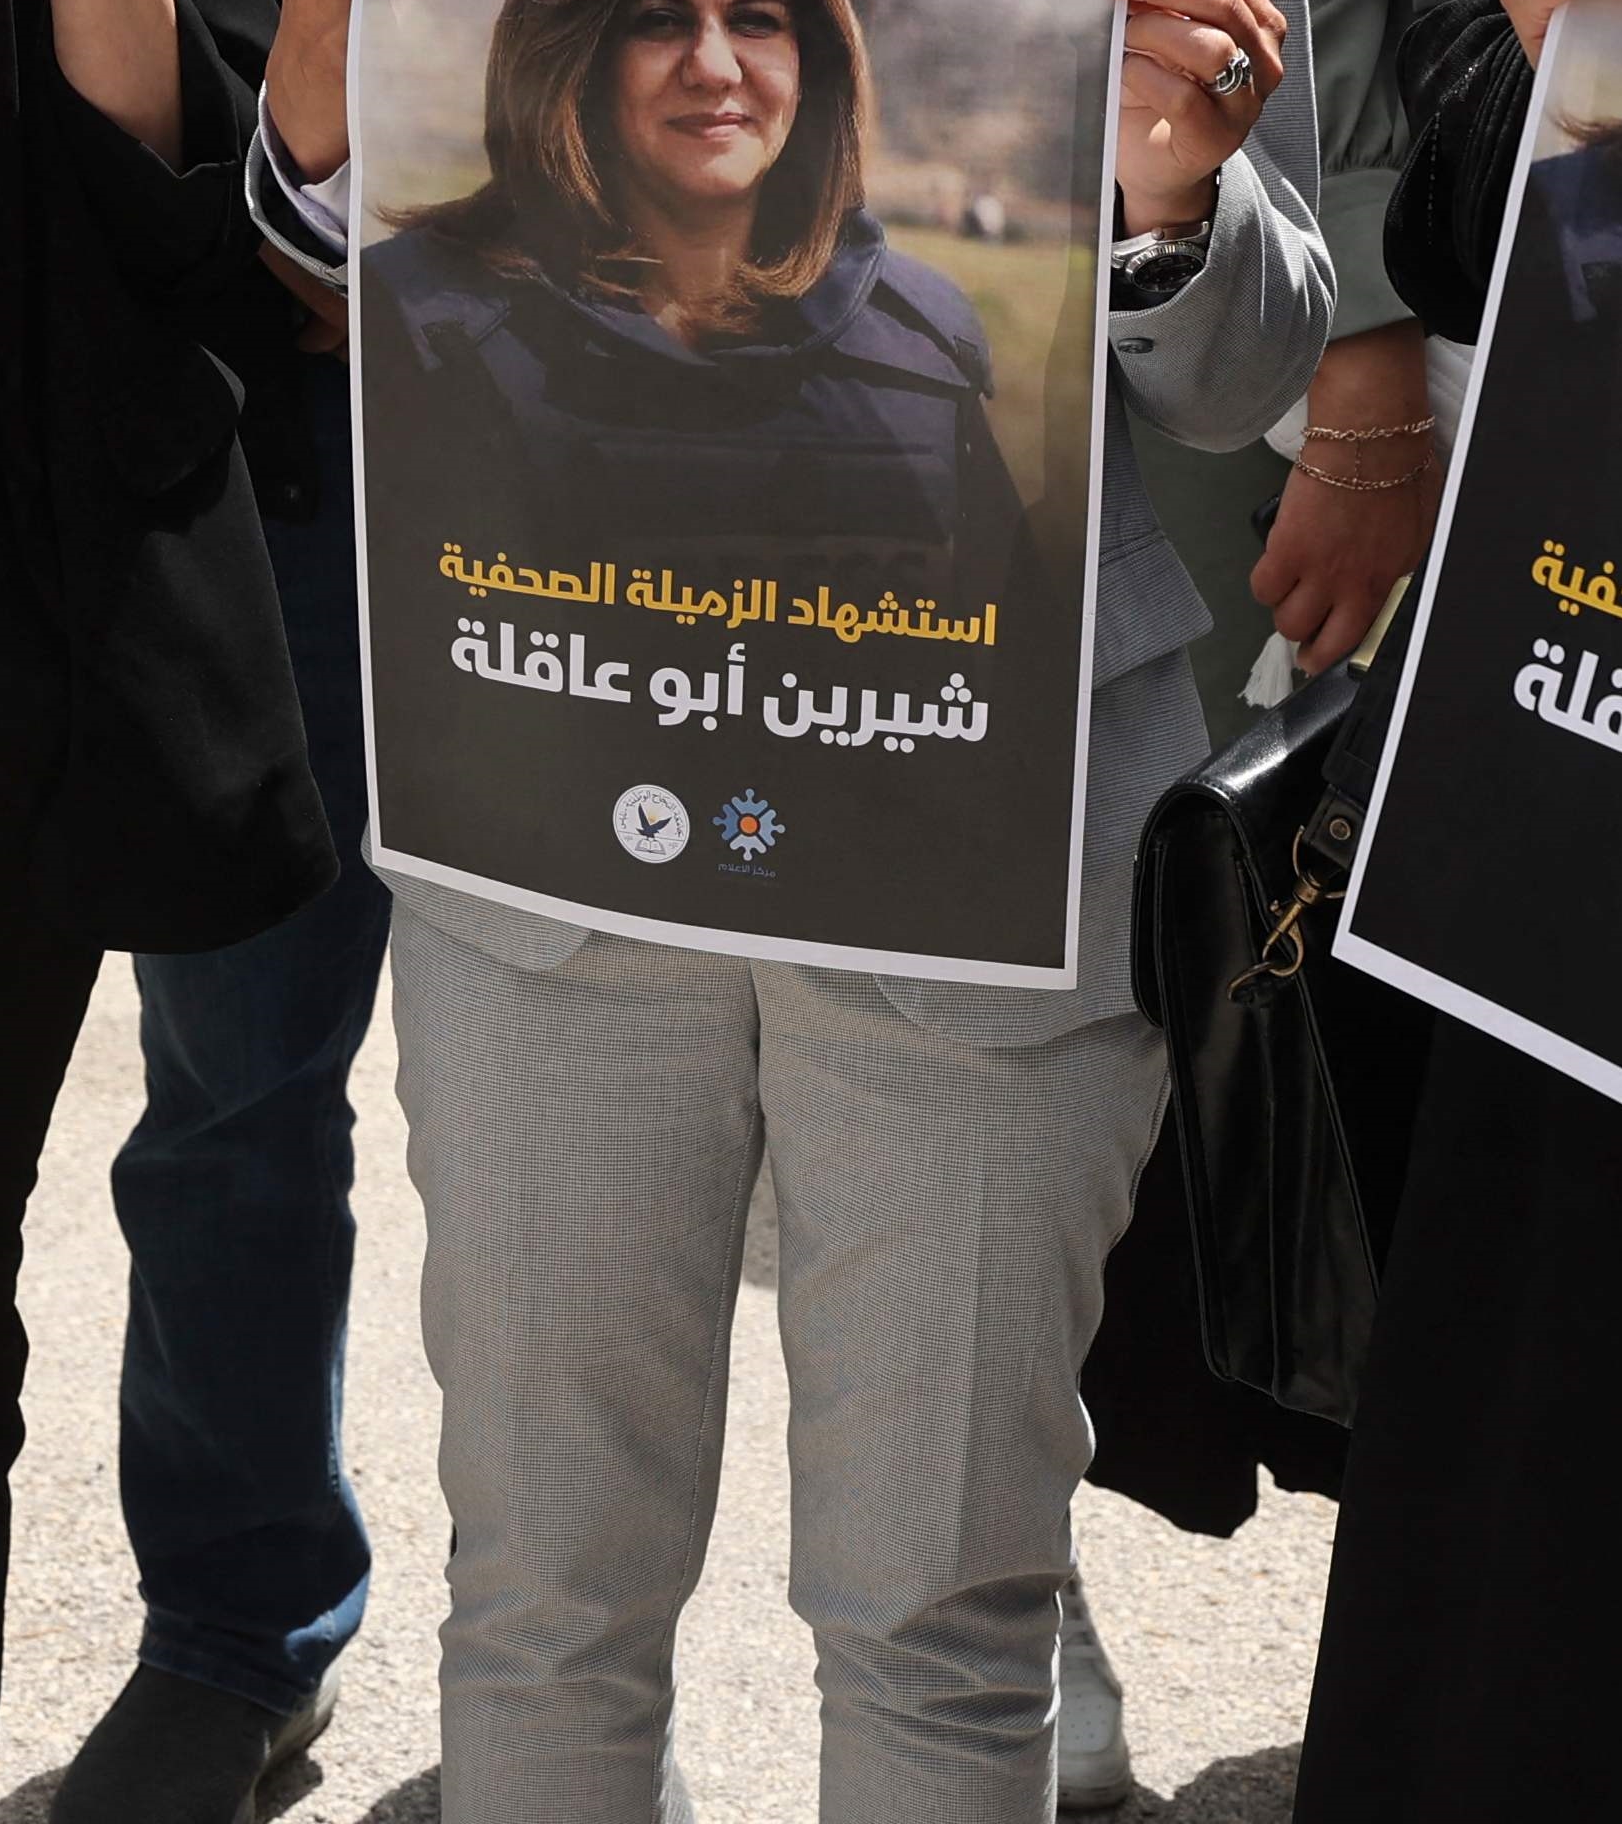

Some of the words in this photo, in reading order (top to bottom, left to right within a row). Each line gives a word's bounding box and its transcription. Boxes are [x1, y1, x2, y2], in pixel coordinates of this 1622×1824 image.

[439, 543, 616, 605] الصحفية
[625, 569, 778, 630] الزميلة
[787, 586, 997, 646] استشهاد
[450, 617, 632, 704] عاقلة
[649, 642, 746, 732] أبو
[762, 672, 989, 754] شيرين
